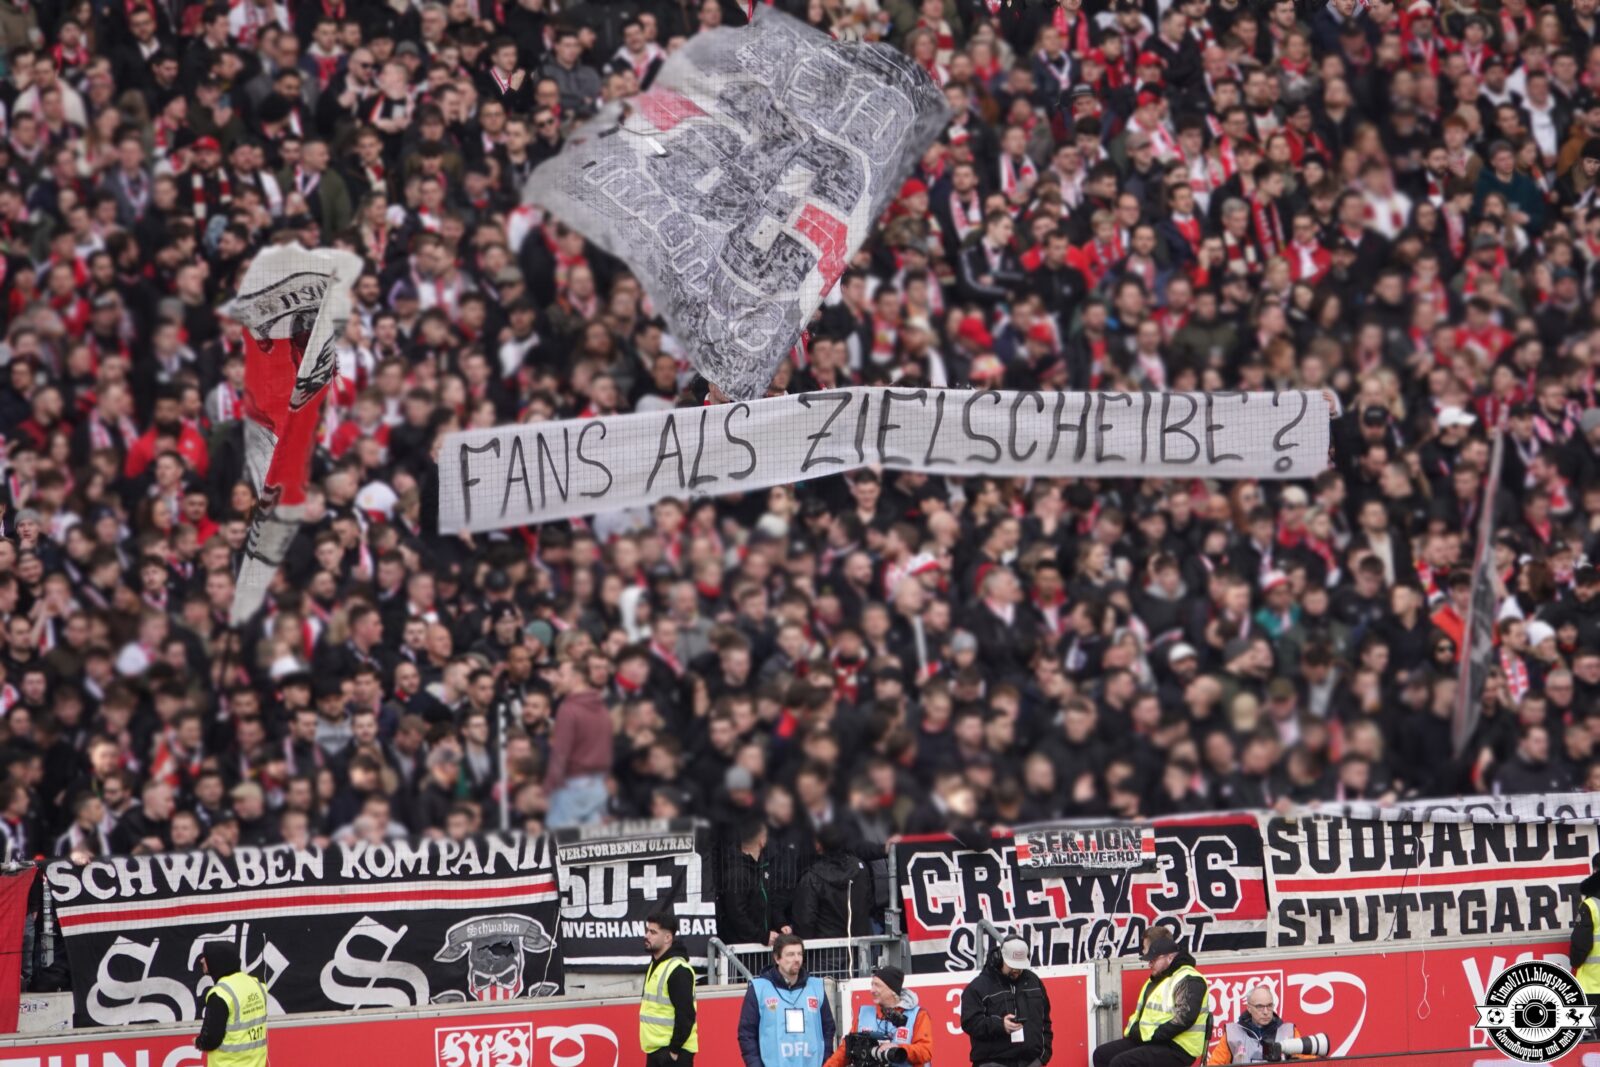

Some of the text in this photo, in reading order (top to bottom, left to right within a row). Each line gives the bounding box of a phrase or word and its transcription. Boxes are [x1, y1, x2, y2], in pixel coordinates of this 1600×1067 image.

[460, 420, 613, 523] FANS
[645, 403, 758, 494] ALS
[798, 387, 1248, 472] ZIELSCHEIBE
[560, 837, 692, 861] VERSTORBENEN ULTRAS
[1028, 827, 1142, 853] SEKTION
[1268, 813, 1590, 875] SÜDBANDE
[45, 842, 324, 902] SCHWABEN
[557, 853, 716, 919] 50+1
[907, 835, 1243, 932] CREW 36
[466, 920, 521, 939] Schwaben
[560, 918, 718, 939] NVERHANBAR
[1277, 883, 1582, 947] STUTTGART
[781, 1041, 812, 1058] DFL
